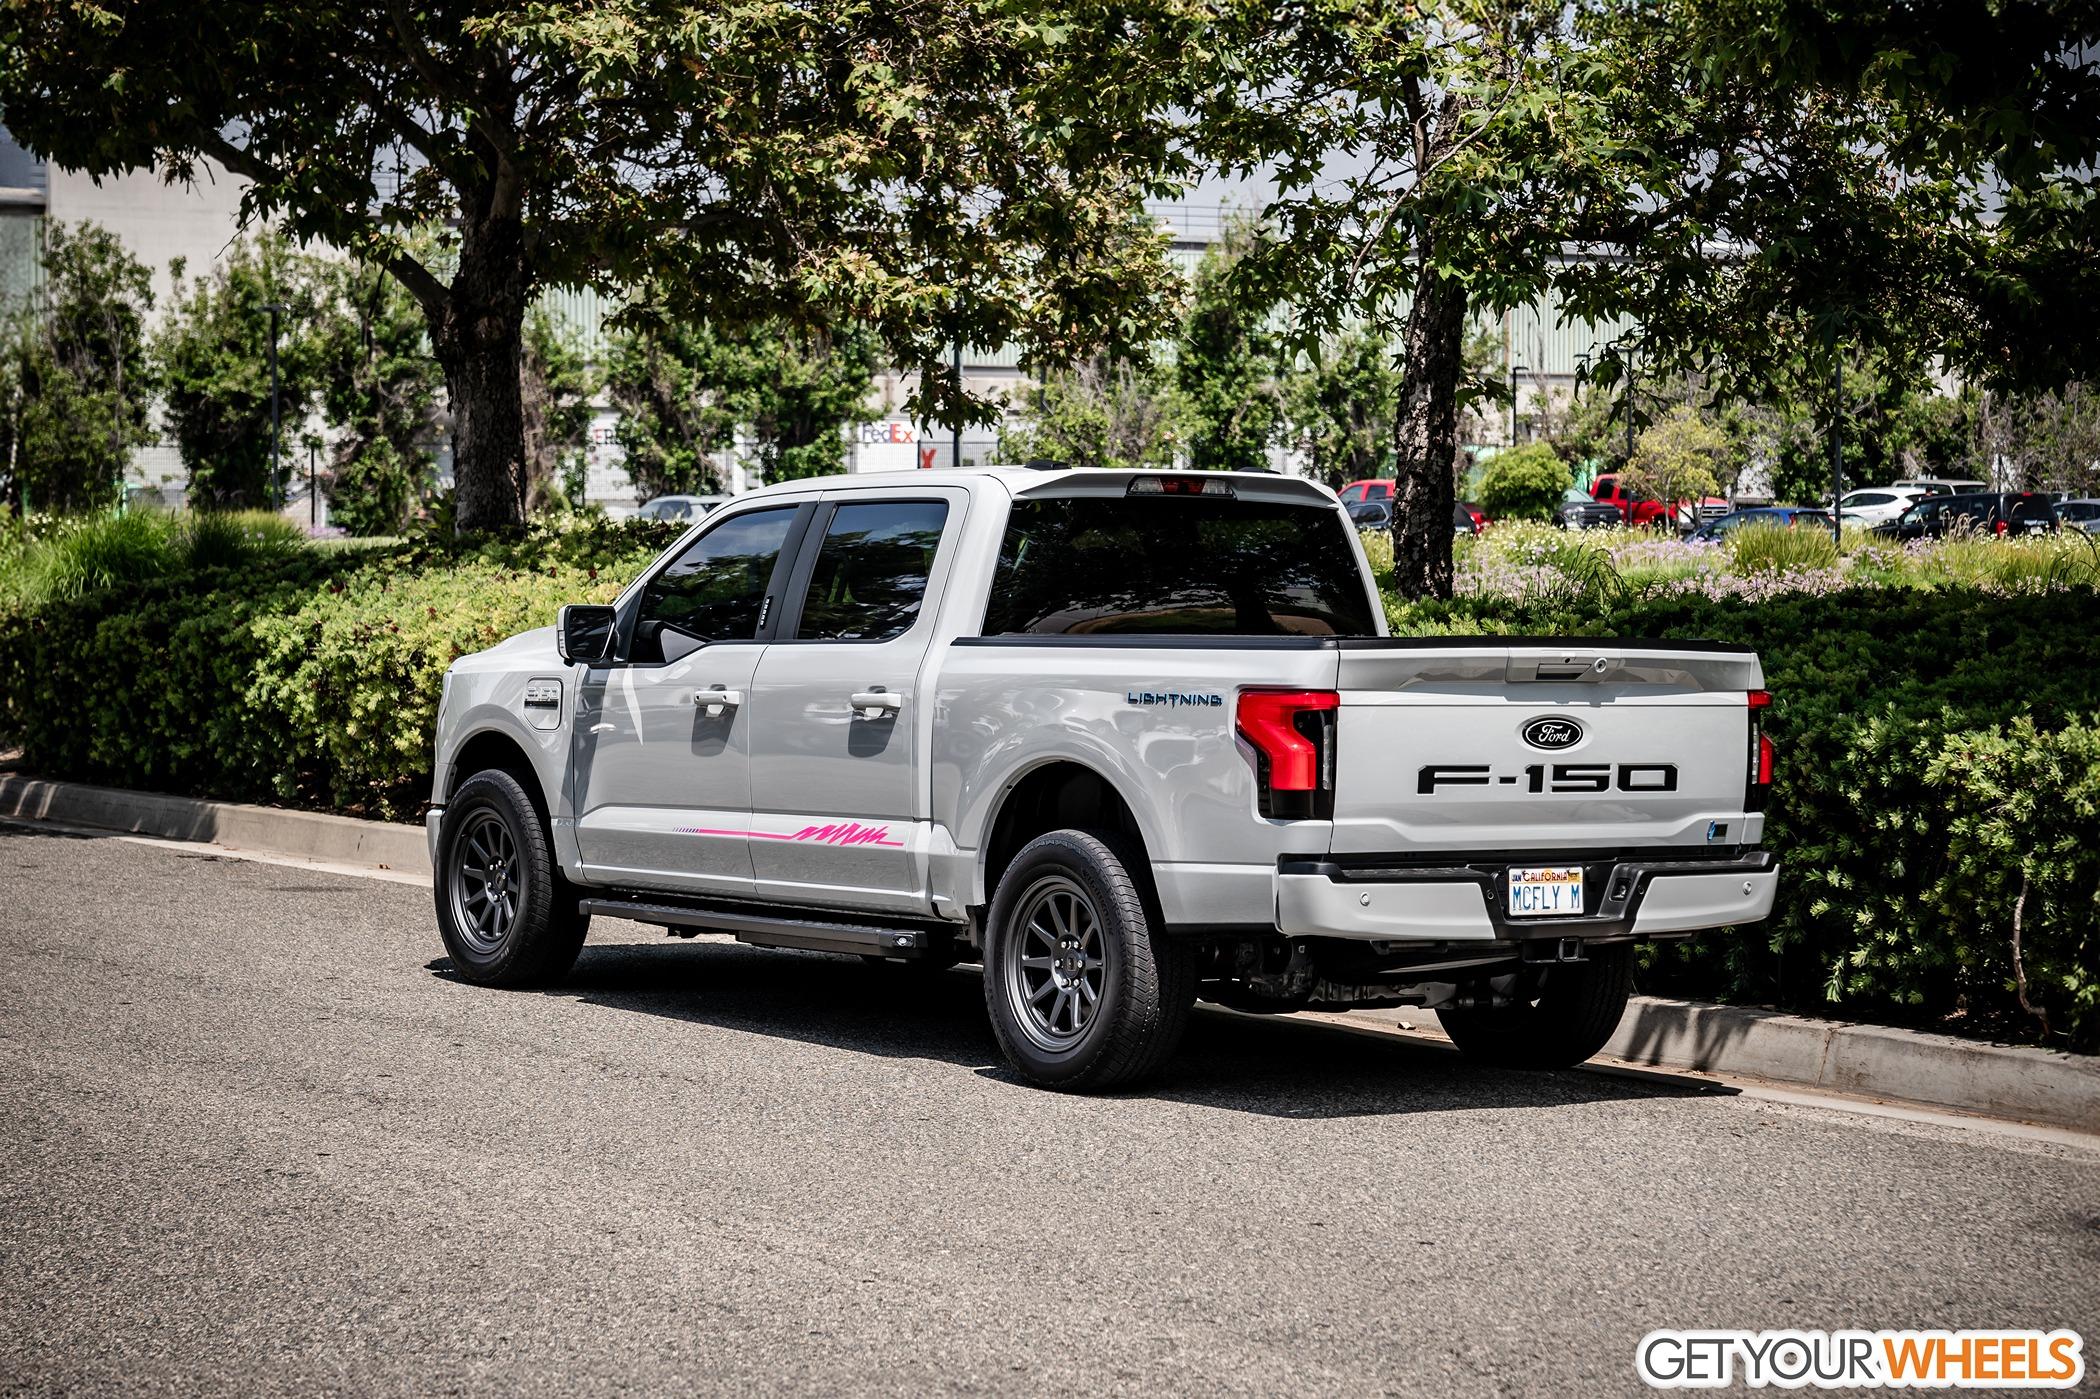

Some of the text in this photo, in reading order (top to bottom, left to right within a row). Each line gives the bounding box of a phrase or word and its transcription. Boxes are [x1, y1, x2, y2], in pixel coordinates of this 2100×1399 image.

[862, 423, 914, 443] FedEx
[1127, 692, 1223, 709] LIGHTNING
[1538, 724, 1571, 742] Ford
[1417, 764, 1679, 795] F-150
[1523, 872, 1568, 882] CALIFORNIA
[1513, 884, 1580, 911] MCFLY M
